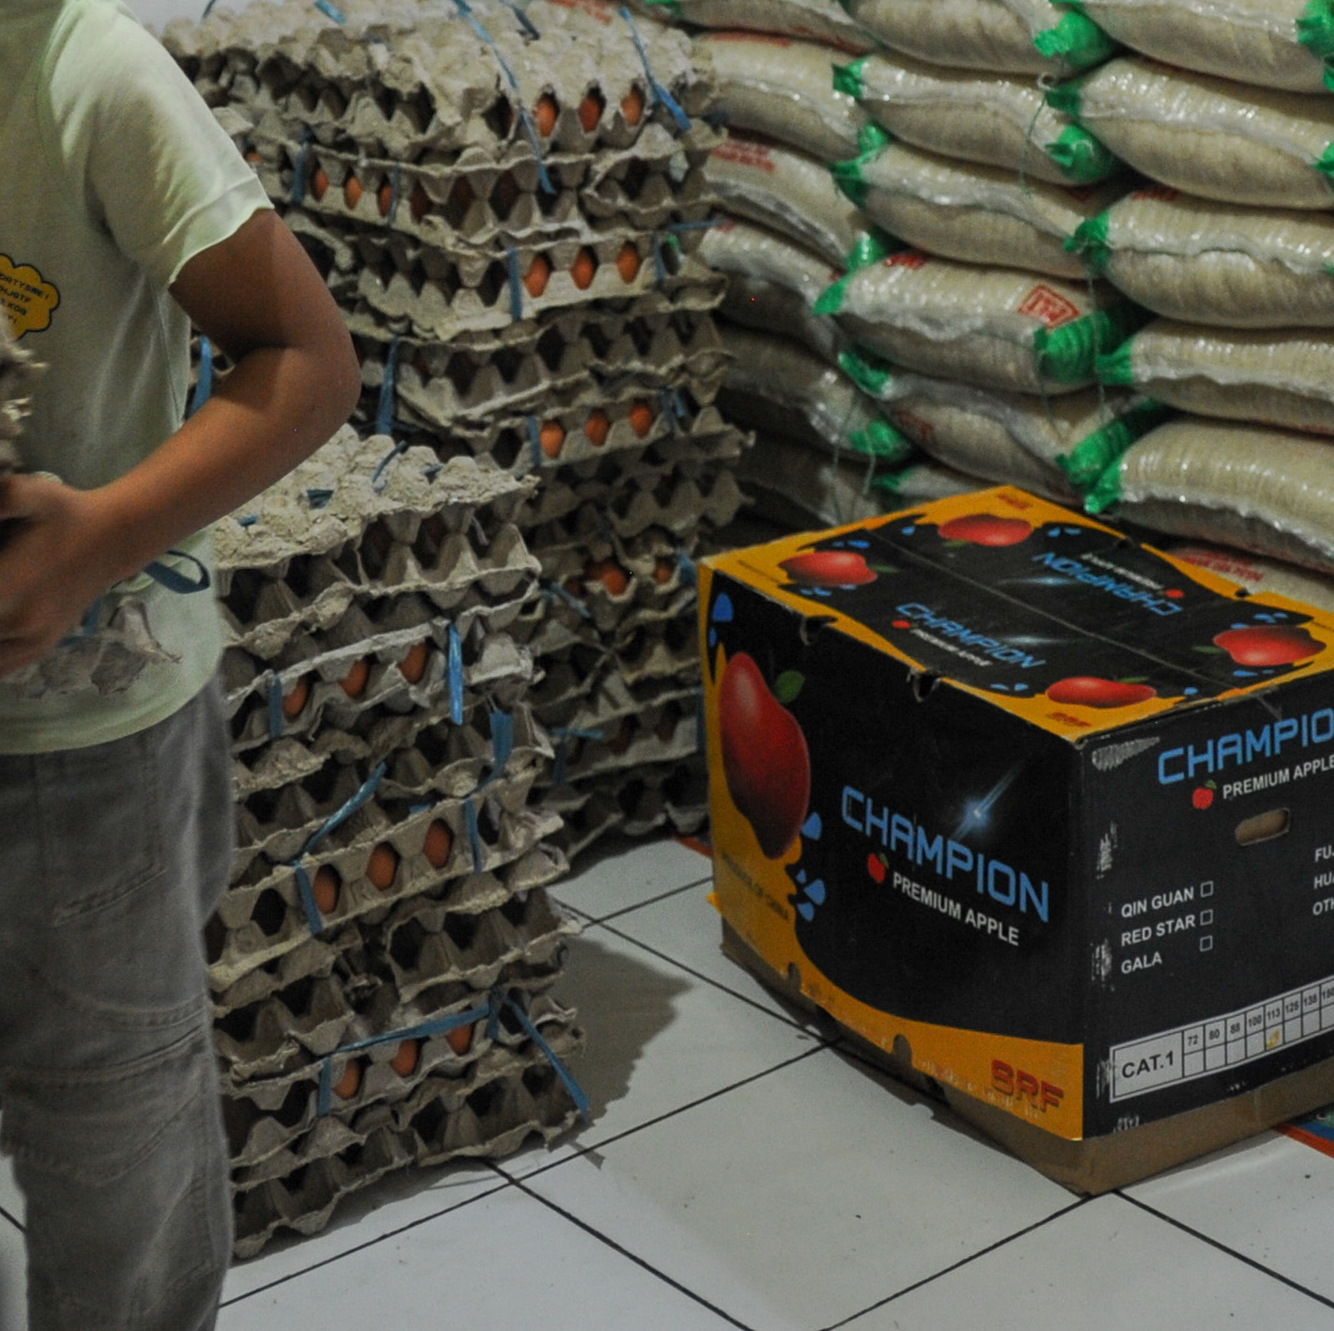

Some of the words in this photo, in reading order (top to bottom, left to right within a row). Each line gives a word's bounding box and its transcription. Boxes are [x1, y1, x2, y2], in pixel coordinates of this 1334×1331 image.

[1033, 552, 1182, 616] CHAMPION
[897, 603, 1047, 668] CHAMPION
[1222, 769, 1291, 800] PREMIUM
[842, 785, 1050, 923] CHAMPION
[892, 871, 961, 920] PREMIUM
[964, 909, 1020, 946] APPLE
[1121, 899, 1148, 919] QIN
[1152, 887, 1194, 911] GUAN
[1121, 923, 1152, 948] RED
[1156, 914, 1196, 937] STAR
[1121, 950, 1163, 975] GALA
[1121, 1050, 1175, 1080] CAT.1
[1187, 1034, 1198, 1045] 72
[1209, 1028, 1220, 1040] 80
[1248, 1015, 1262, 1028] 100
[1267, 1007, 1281, 1021] 113
[1285, 1001, 1299, 1014] 125
